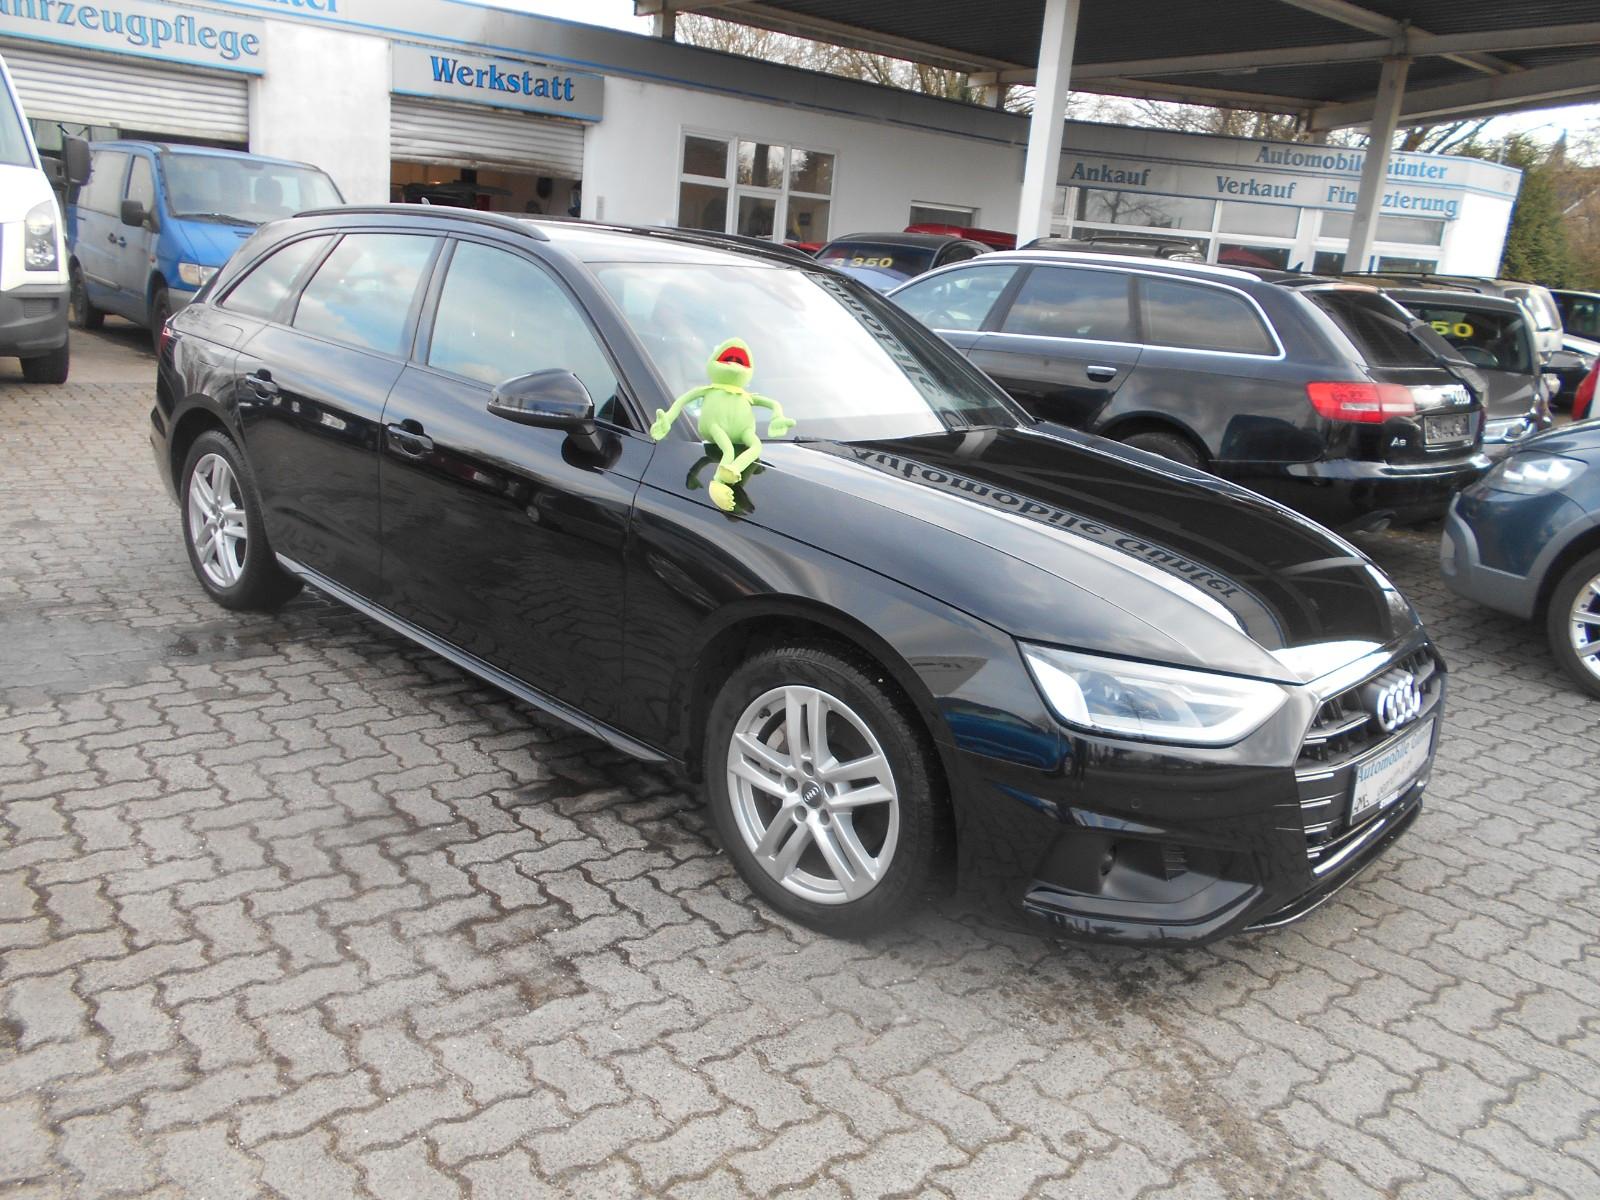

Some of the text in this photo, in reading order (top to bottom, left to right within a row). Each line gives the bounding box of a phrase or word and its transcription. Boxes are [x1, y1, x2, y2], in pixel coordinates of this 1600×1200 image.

[430, 56, 575, 102] Werkstatt
[1071, 163, 1151, 187] Ankauf
[1216, 176, 1297, 199] Verkauf
